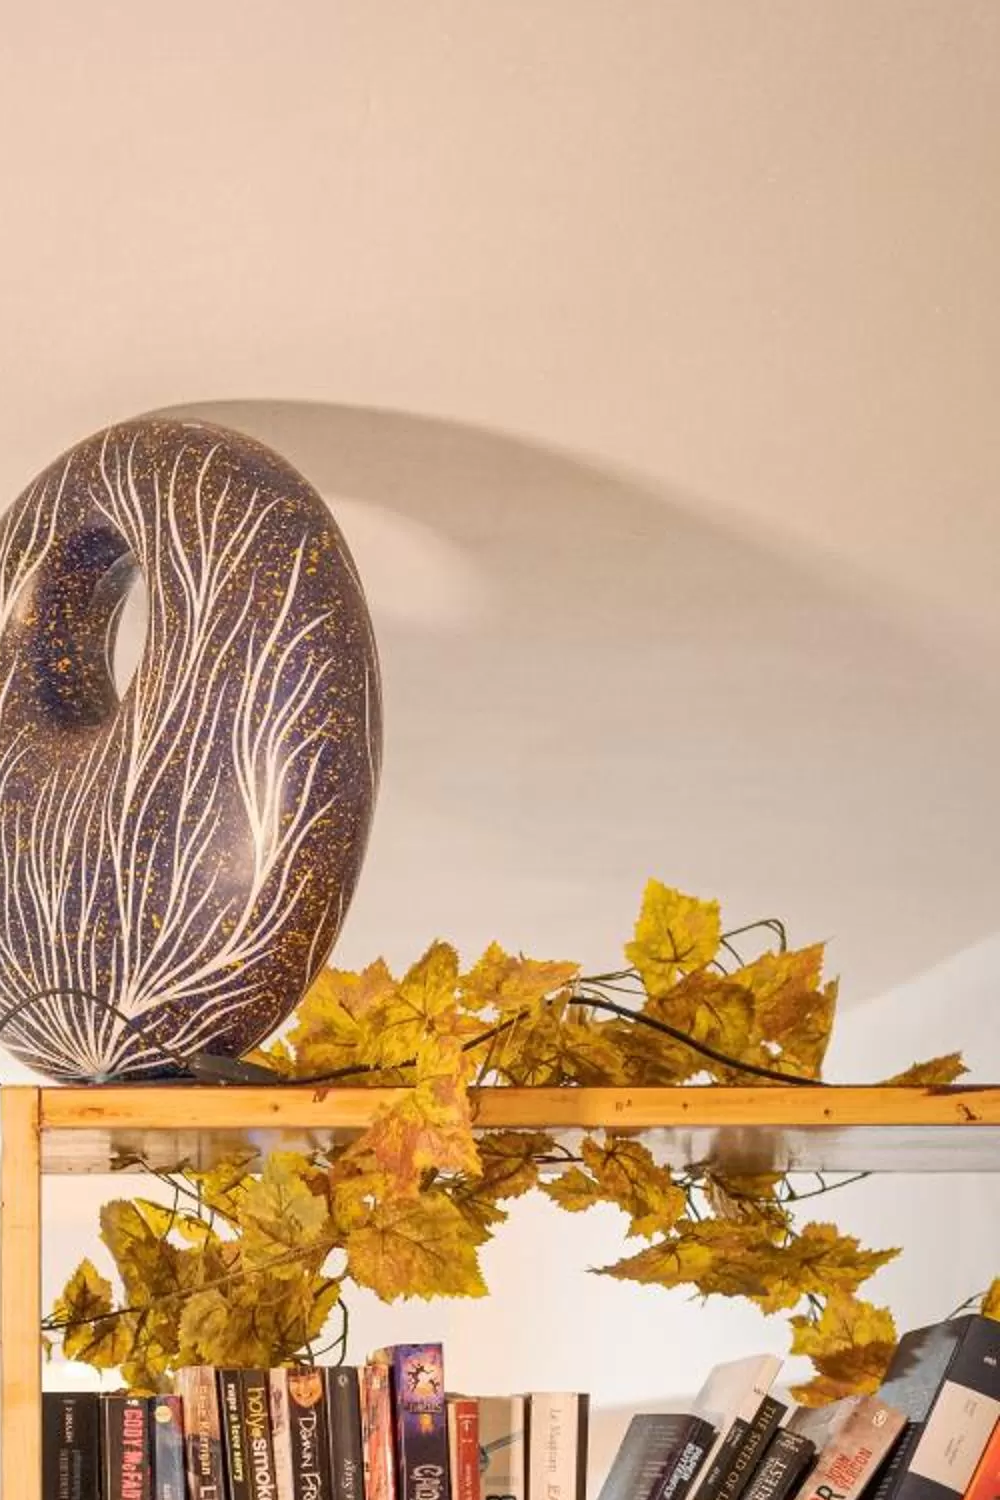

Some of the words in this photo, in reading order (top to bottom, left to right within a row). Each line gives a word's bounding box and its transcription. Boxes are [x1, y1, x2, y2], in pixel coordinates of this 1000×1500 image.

[224, 1383, 237, 1411] rape
[123, 1408, 141, 1446] CODY
[756, 1404, 777, 1429] THE
[230, 1450, 245, 1482] story
